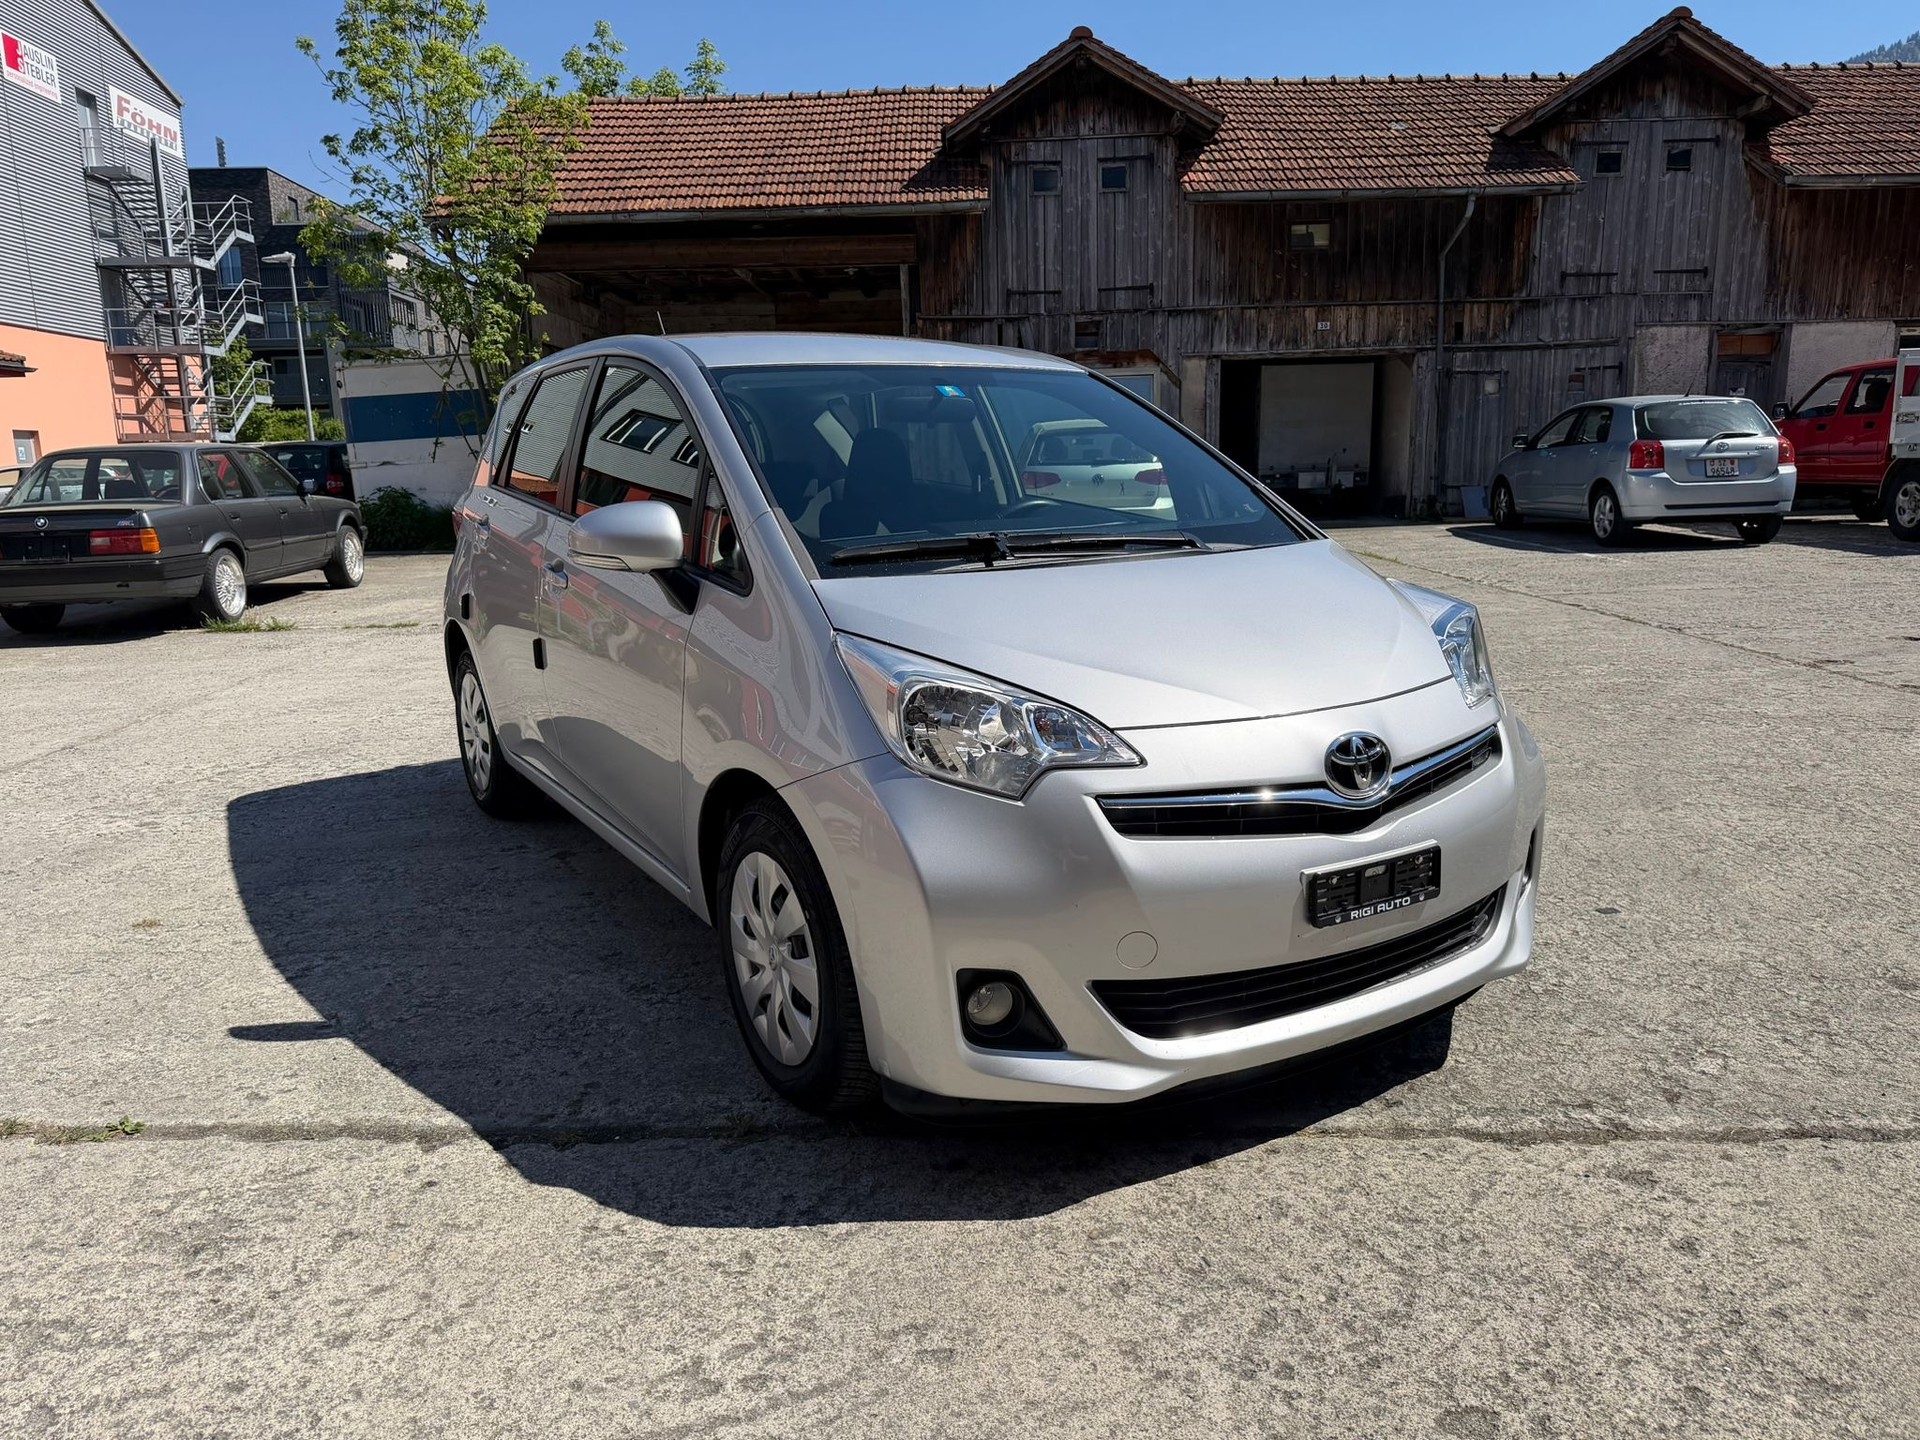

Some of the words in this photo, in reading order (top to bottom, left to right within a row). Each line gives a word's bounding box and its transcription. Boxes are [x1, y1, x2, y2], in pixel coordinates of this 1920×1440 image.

[16, 40, 54, 71] JAUSLIN
[17, 57, 57, 88] STEBLER
[117, 94, 177, 143] FÖHN
[1351, 906, 1374, 920] RIGI
[1377, 897, 1411, 913] AUTO
